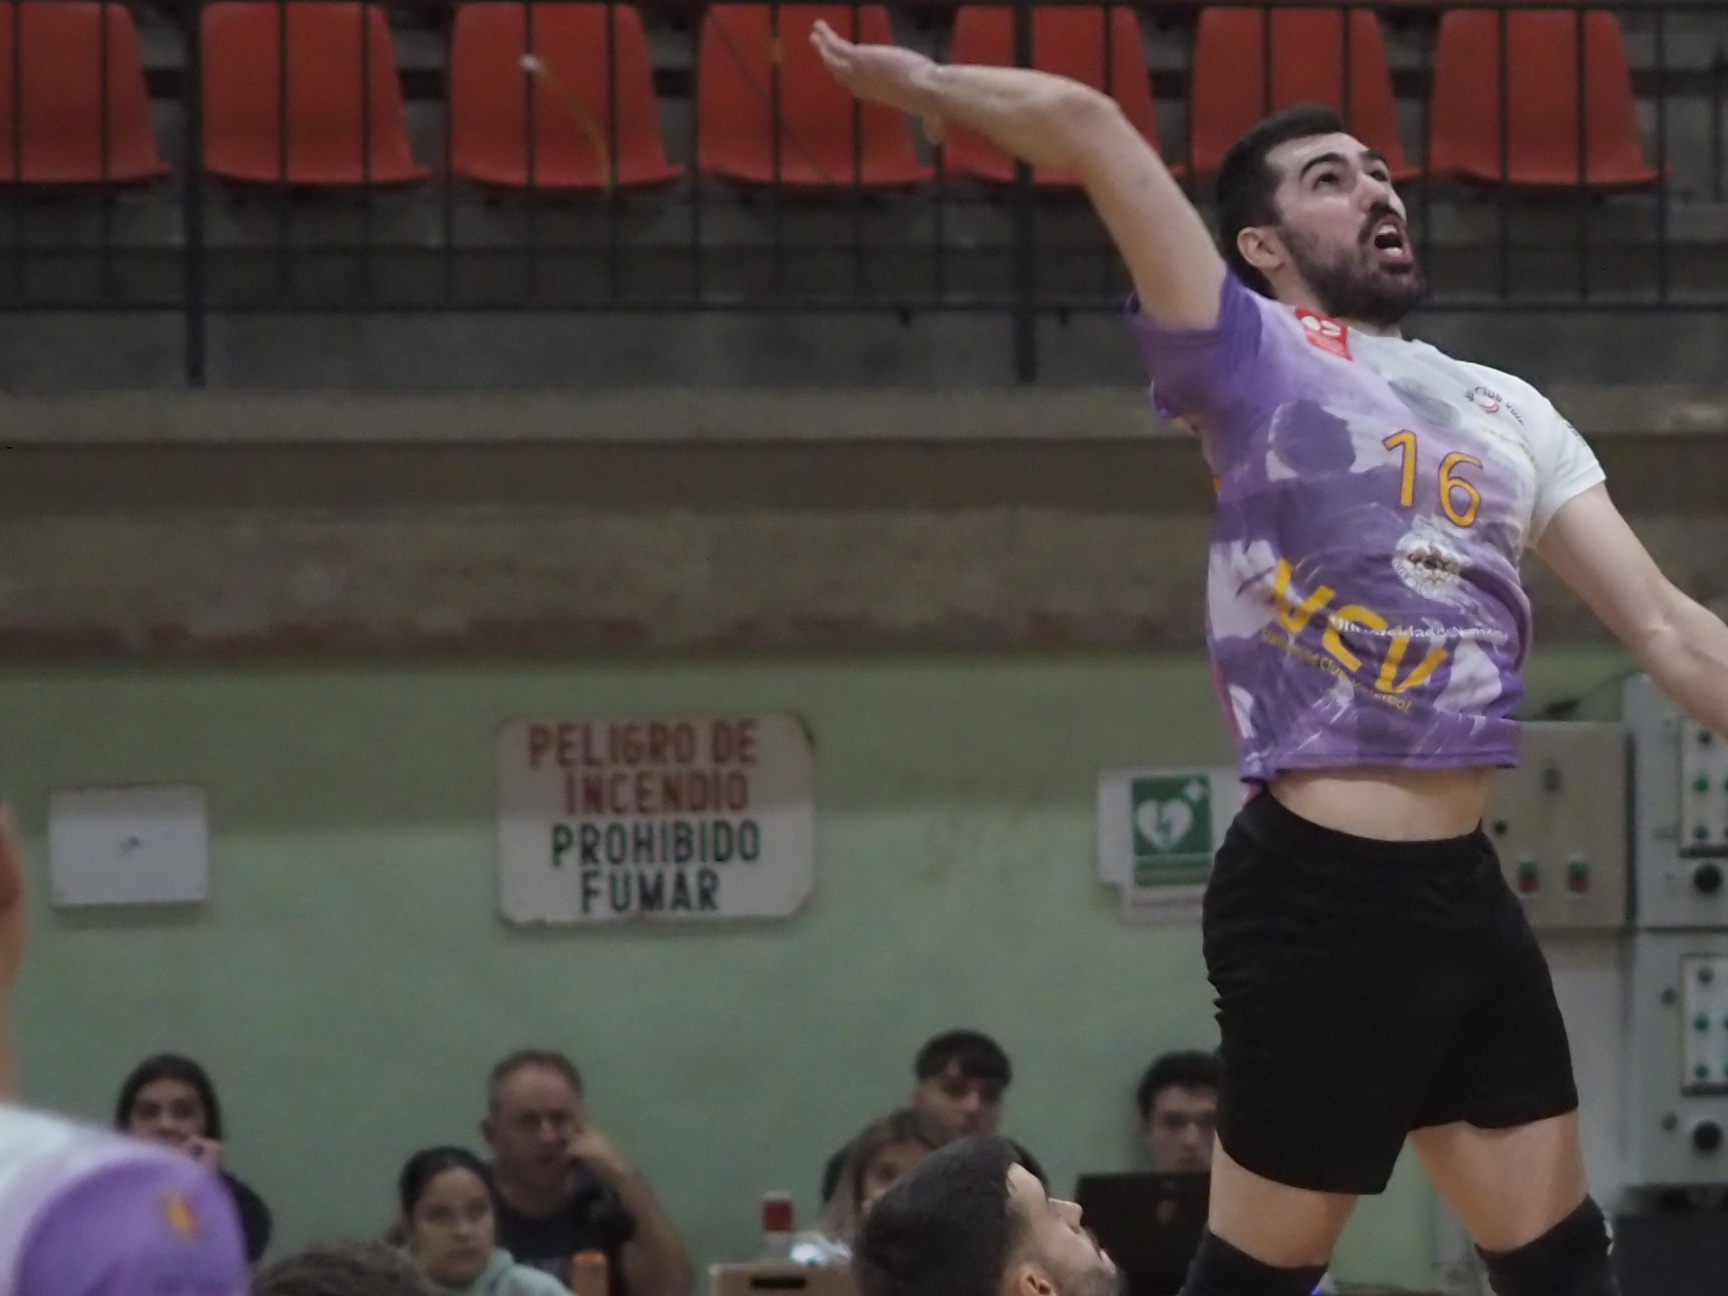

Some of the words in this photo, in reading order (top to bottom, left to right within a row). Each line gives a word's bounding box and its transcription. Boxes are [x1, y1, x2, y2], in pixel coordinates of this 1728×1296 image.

[1382, 429, 1484, 528] 16
[529, 720, 696, 768] PELIGRO
[711, 718, 758, 766] DE
[565, 769, 748, 815] INCENDIO
[552, 819, 762, 867] PROHIBIDO
[580, 868, 721, 914] FUMAR
